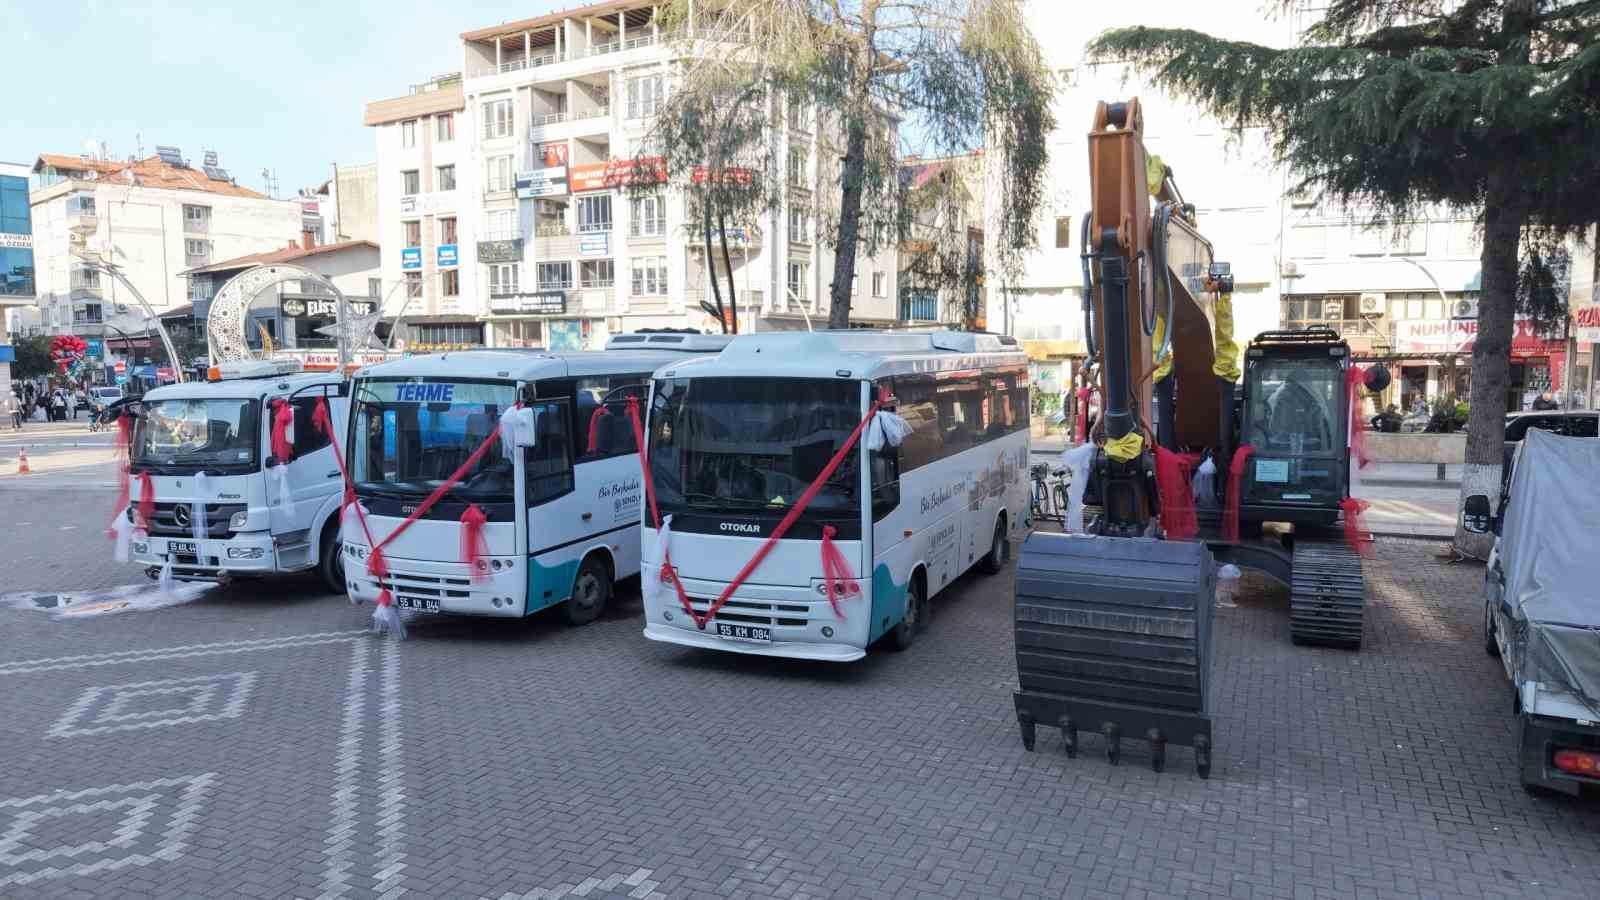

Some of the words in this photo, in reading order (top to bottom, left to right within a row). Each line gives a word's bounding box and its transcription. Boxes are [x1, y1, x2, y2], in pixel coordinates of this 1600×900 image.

[396, 384, 455, 402] TERME
[720, 522, 760, 533] OTOKAR
[400, 598, 409, 608] 55
[720, 624, 731, 635] 55
[735, 626, 748, 638] KM
[752, 628, 769, 640] 084
